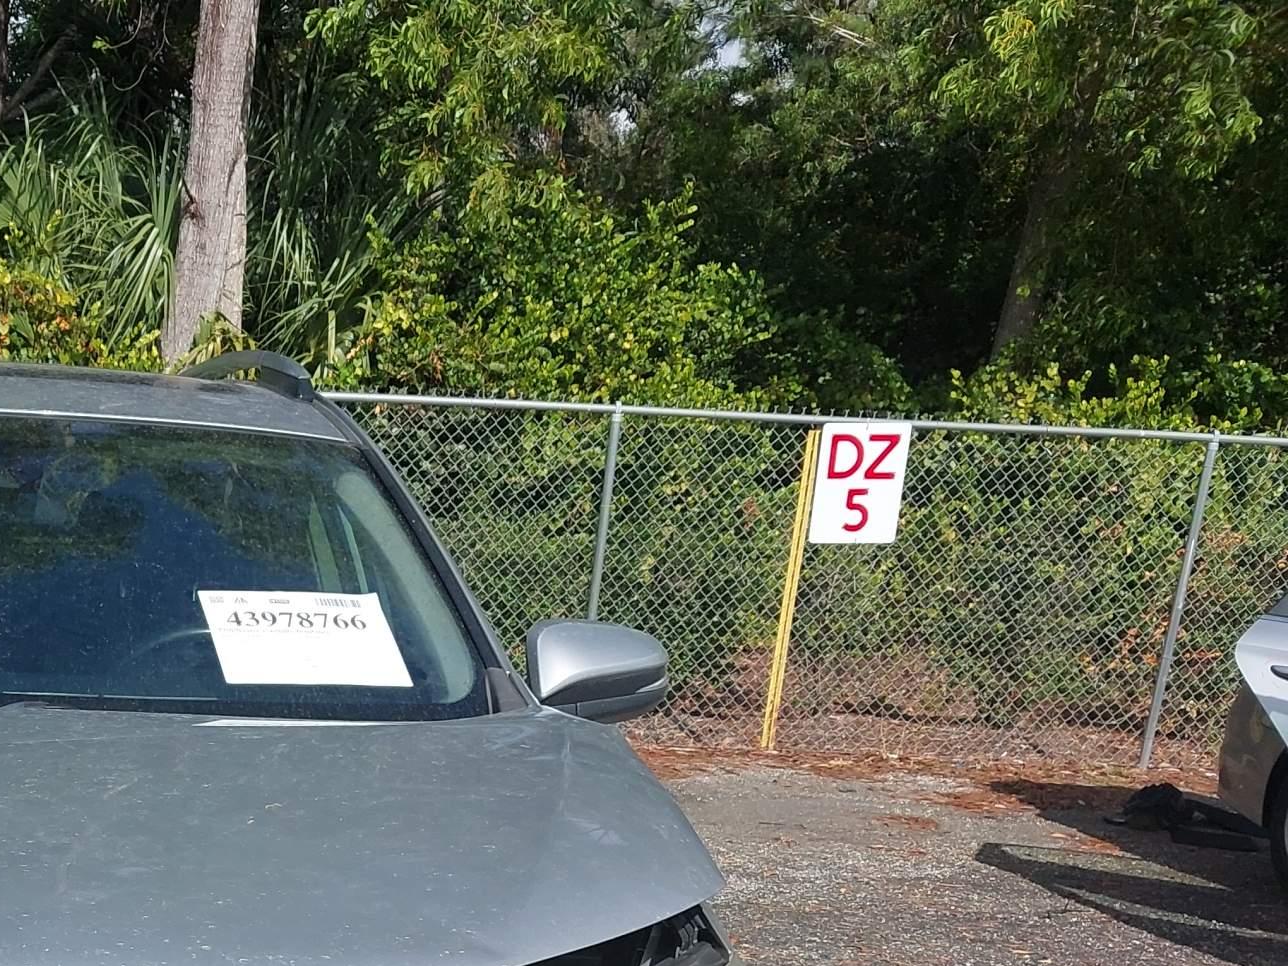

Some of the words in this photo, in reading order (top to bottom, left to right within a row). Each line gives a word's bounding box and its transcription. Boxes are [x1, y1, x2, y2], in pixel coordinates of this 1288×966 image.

[827, 433, 902, 479] DZ
[841, 488, 869, 532] 5
[227, 611, 367, 630] 43978766
